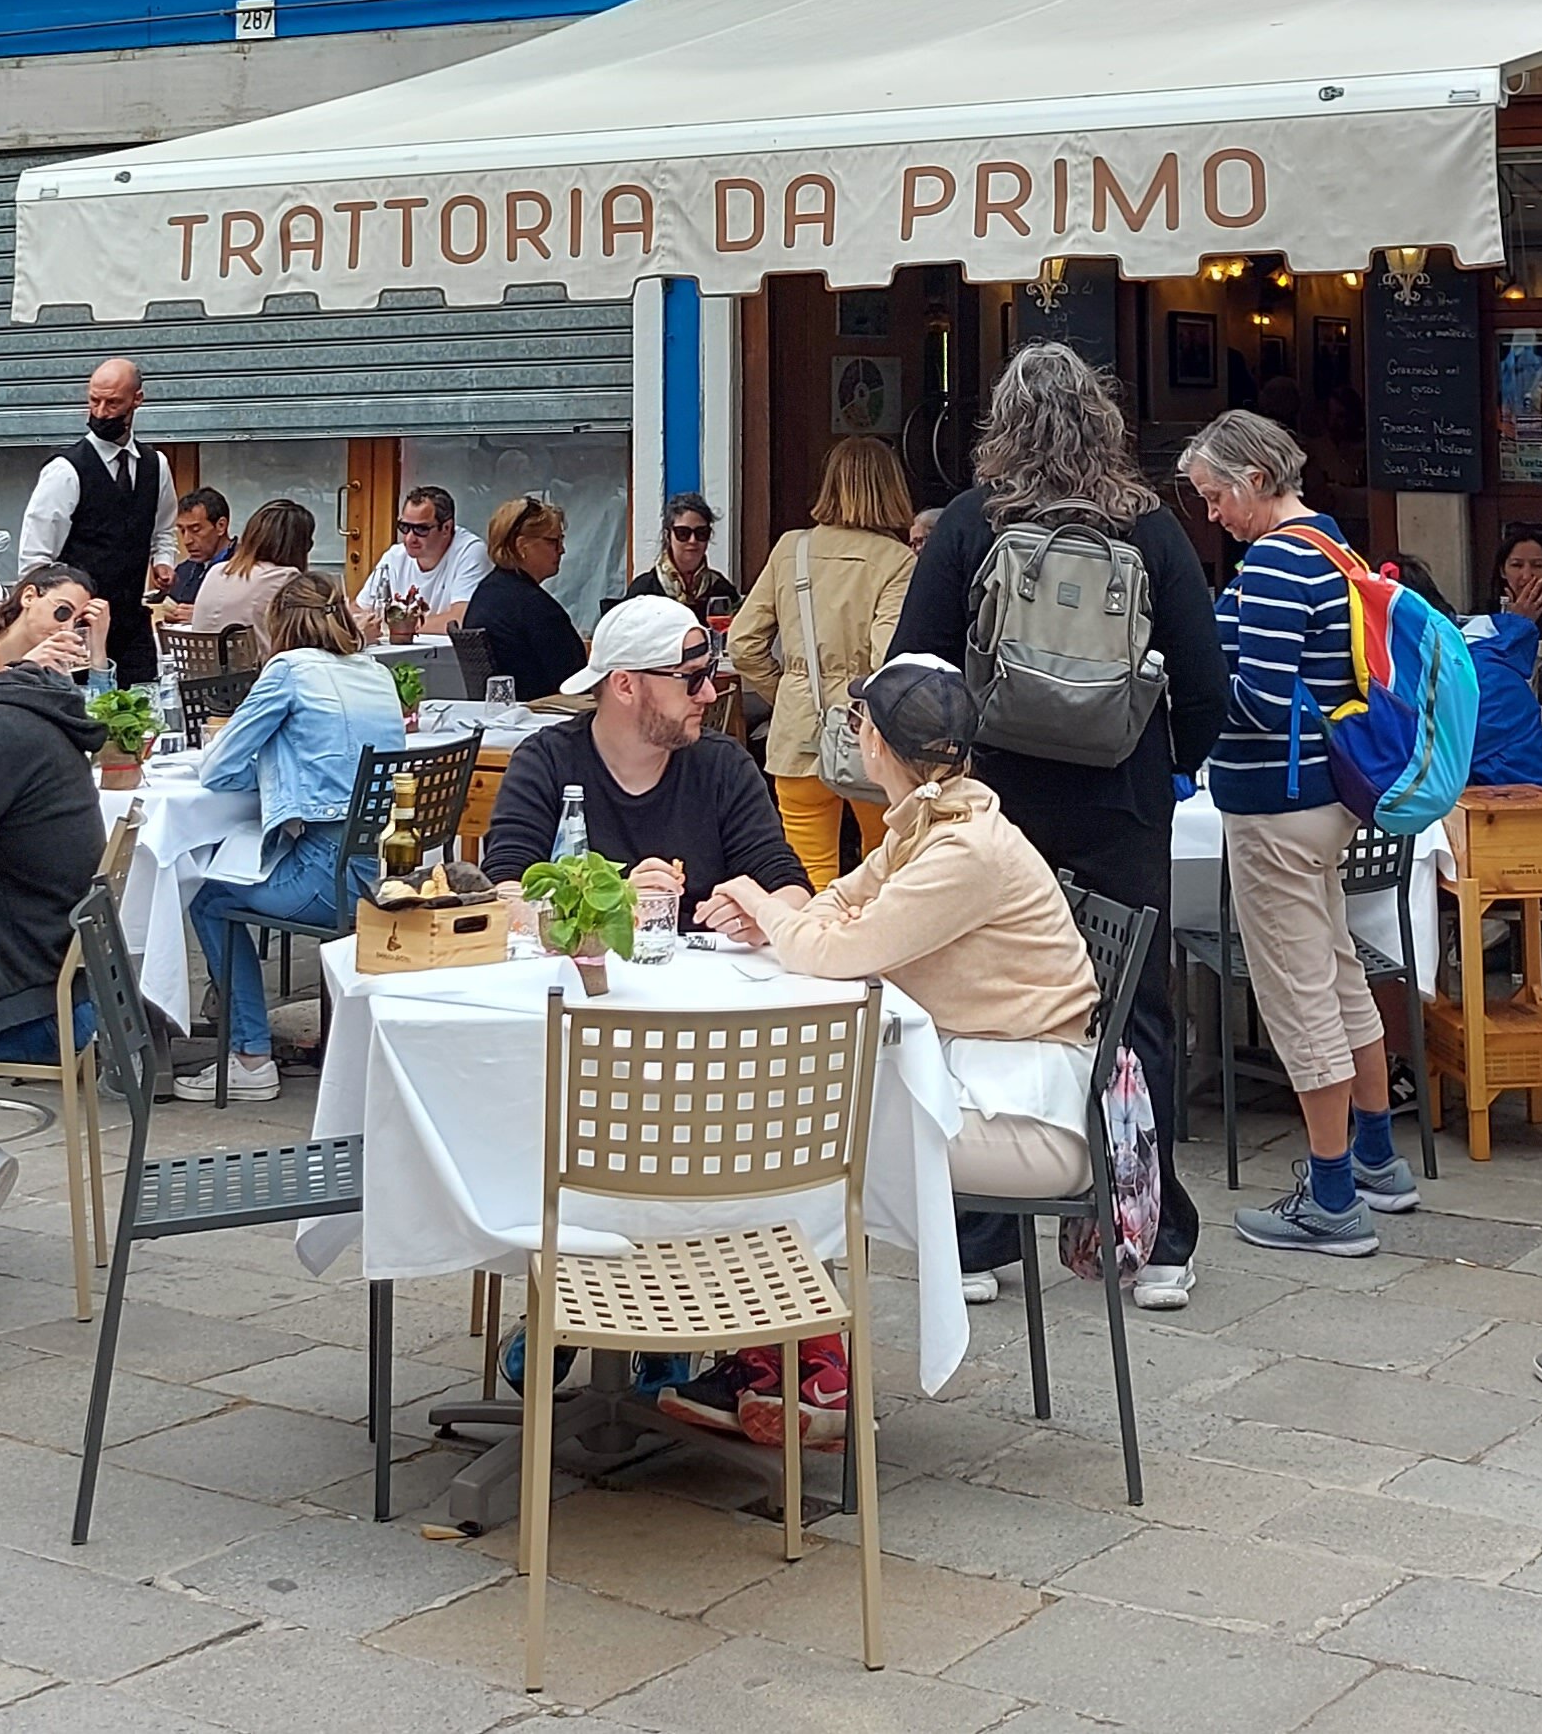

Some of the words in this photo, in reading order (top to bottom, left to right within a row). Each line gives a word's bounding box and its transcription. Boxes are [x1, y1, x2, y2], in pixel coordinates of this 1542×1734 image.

[242, 9, 273, 30] 287
[167, 183, 655, 282] TRATTORIA
[714, 172, 836, 253] DA
[899, 146, 1268, 241] PRIMO
